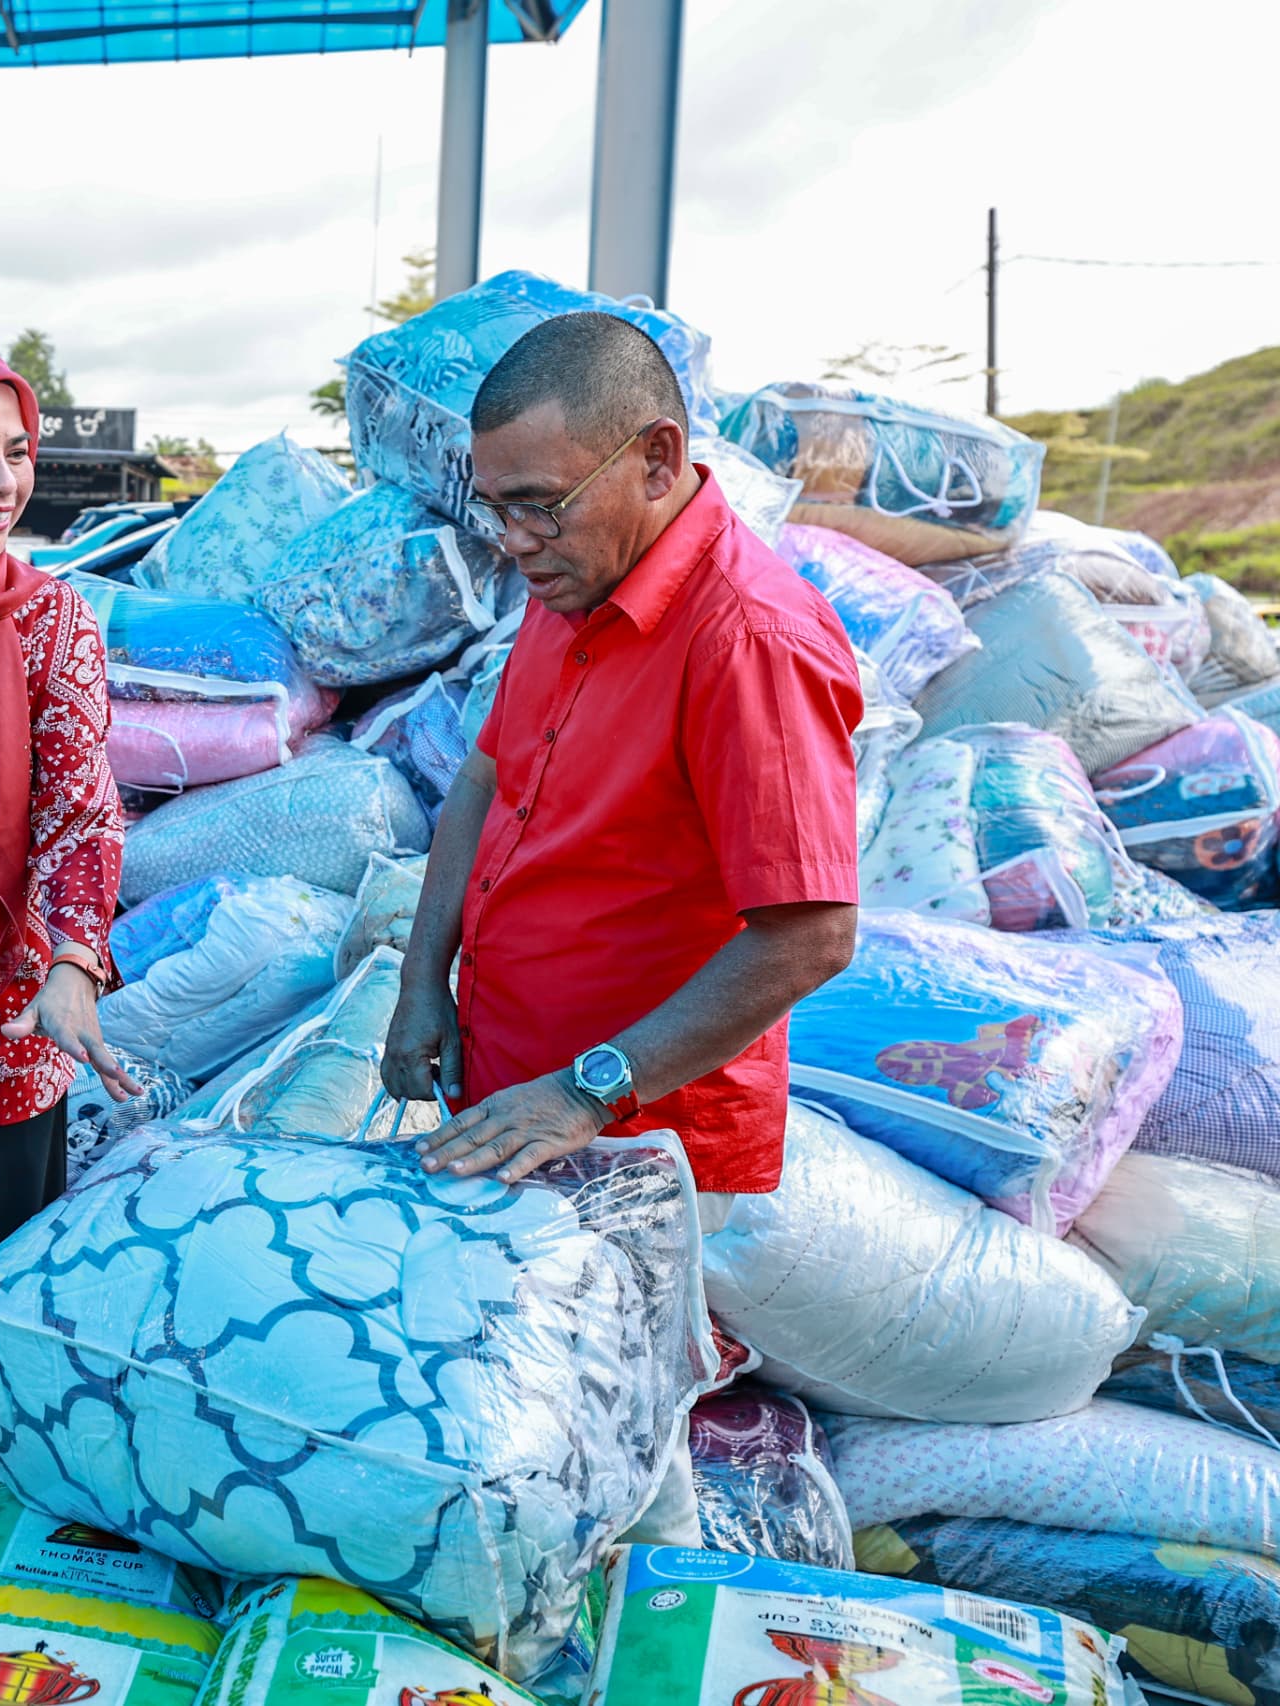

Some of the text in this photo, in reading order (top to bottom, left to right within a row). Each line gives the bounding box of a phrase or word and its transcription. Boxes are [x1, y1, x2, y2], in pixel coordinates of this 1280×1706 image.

[39, 1549, 144, 1571] THOMAS CUP
[15, 1563, 59, 1578] Mutiara
[758, 1611, 801, 1624] CUP
[314, 1652, 344, 1664] SUPER
